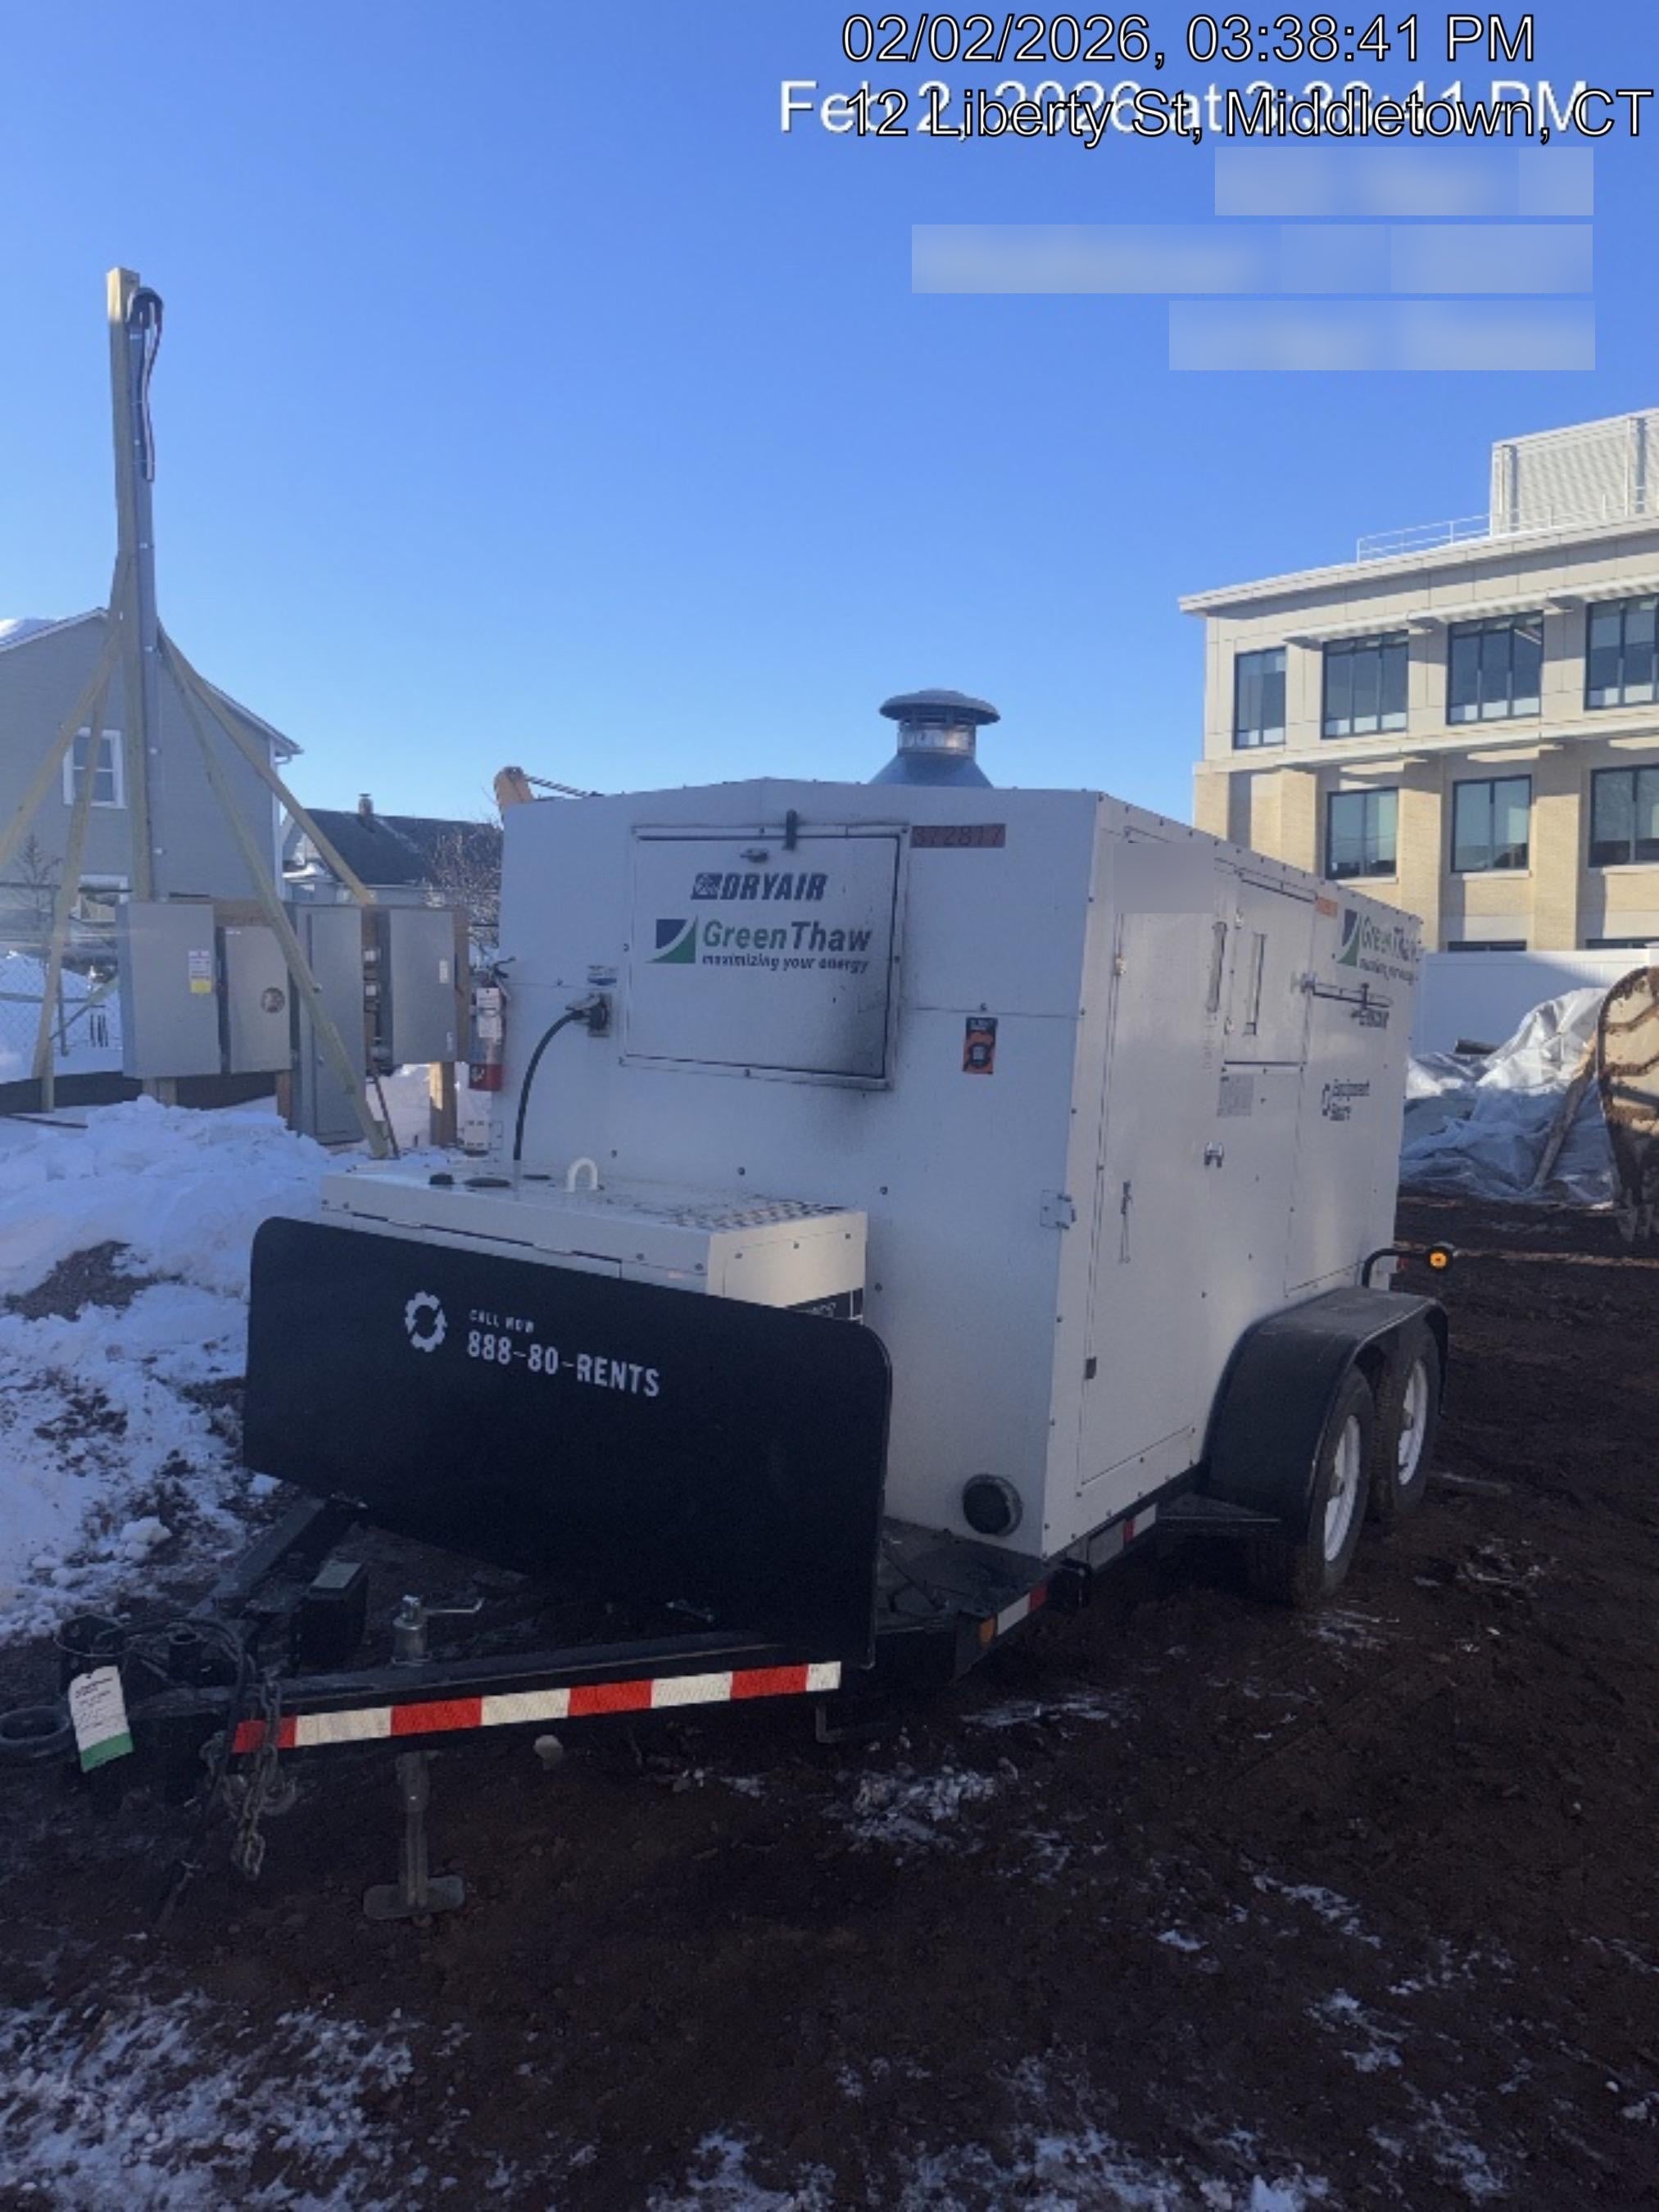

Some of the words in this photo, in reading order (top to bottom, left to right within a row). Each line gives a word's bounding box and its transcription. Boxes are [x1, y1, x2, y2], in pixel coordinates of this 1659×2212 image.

[719, 873, 828, 900] DRYAIR
[702, 918, 873, 952] GreenThaw
[782, 957, 817, 972] your
[467, 1330, 660, 1397] 888-80-RENTS
